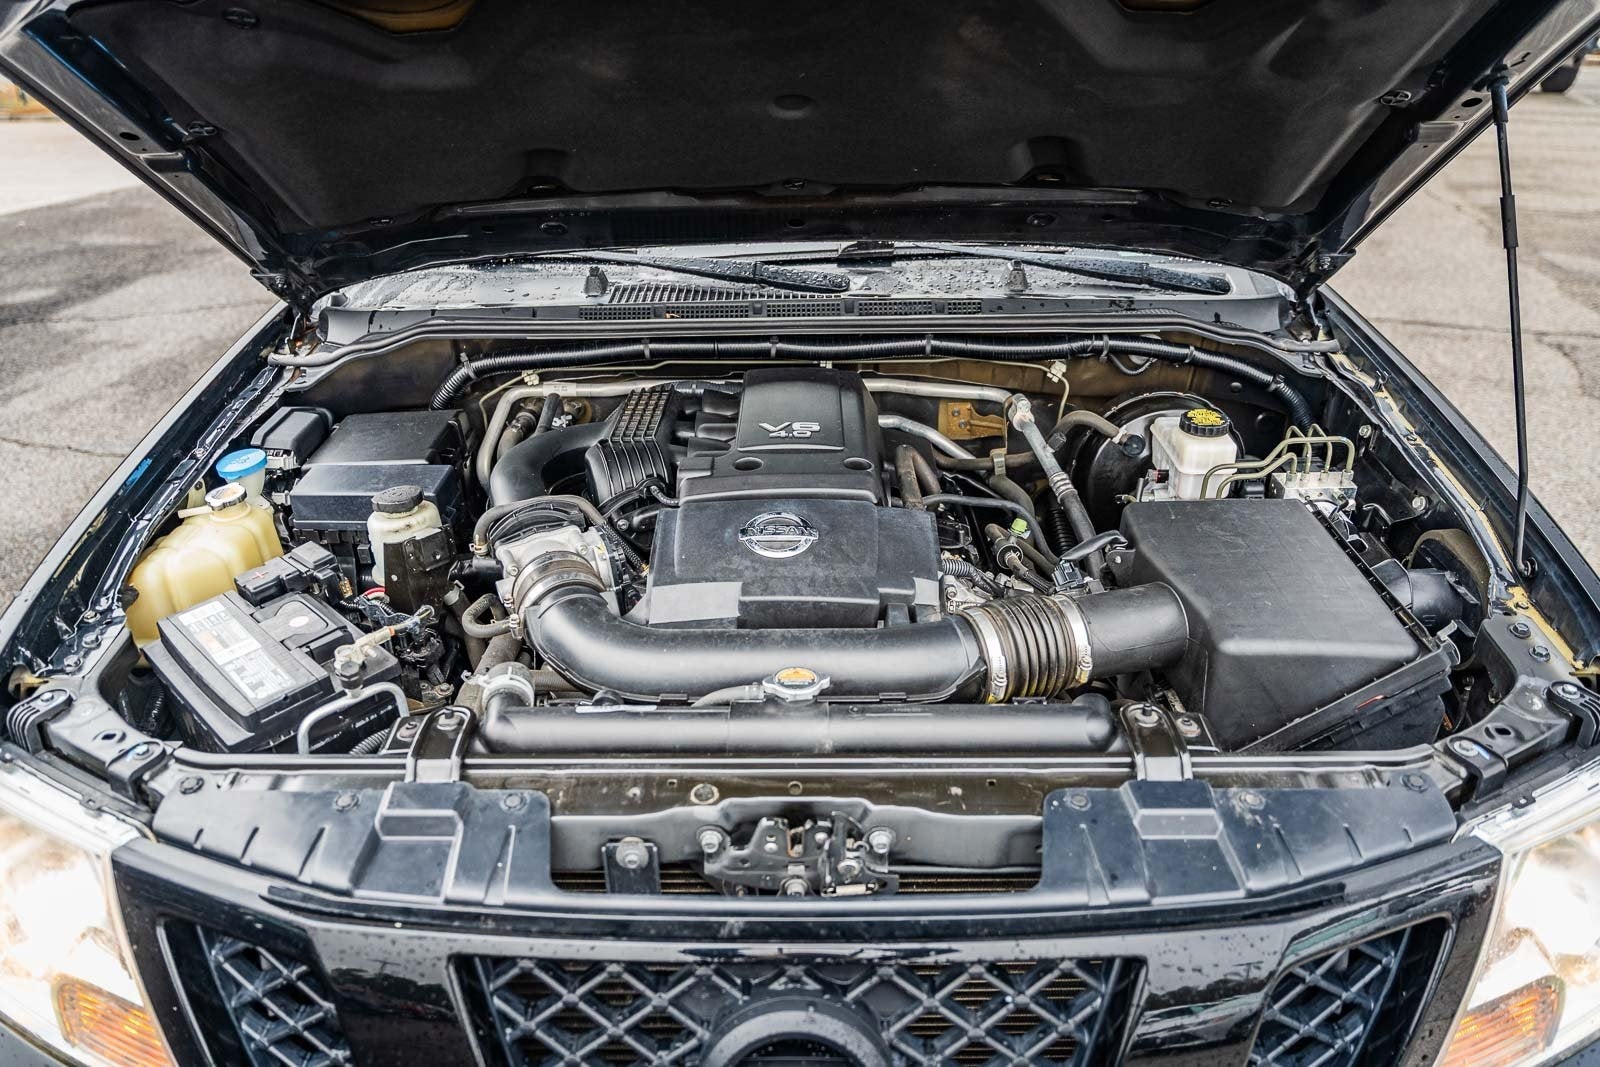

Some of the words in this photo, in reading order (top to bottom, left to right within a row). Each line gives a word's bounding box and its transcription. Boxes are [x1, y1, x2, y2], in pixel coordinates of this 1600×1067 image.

[758, 421, 820, 432] V6
[769, 430, 812, 438] 4.0
[746, 525, 813, 536] NISSAN
